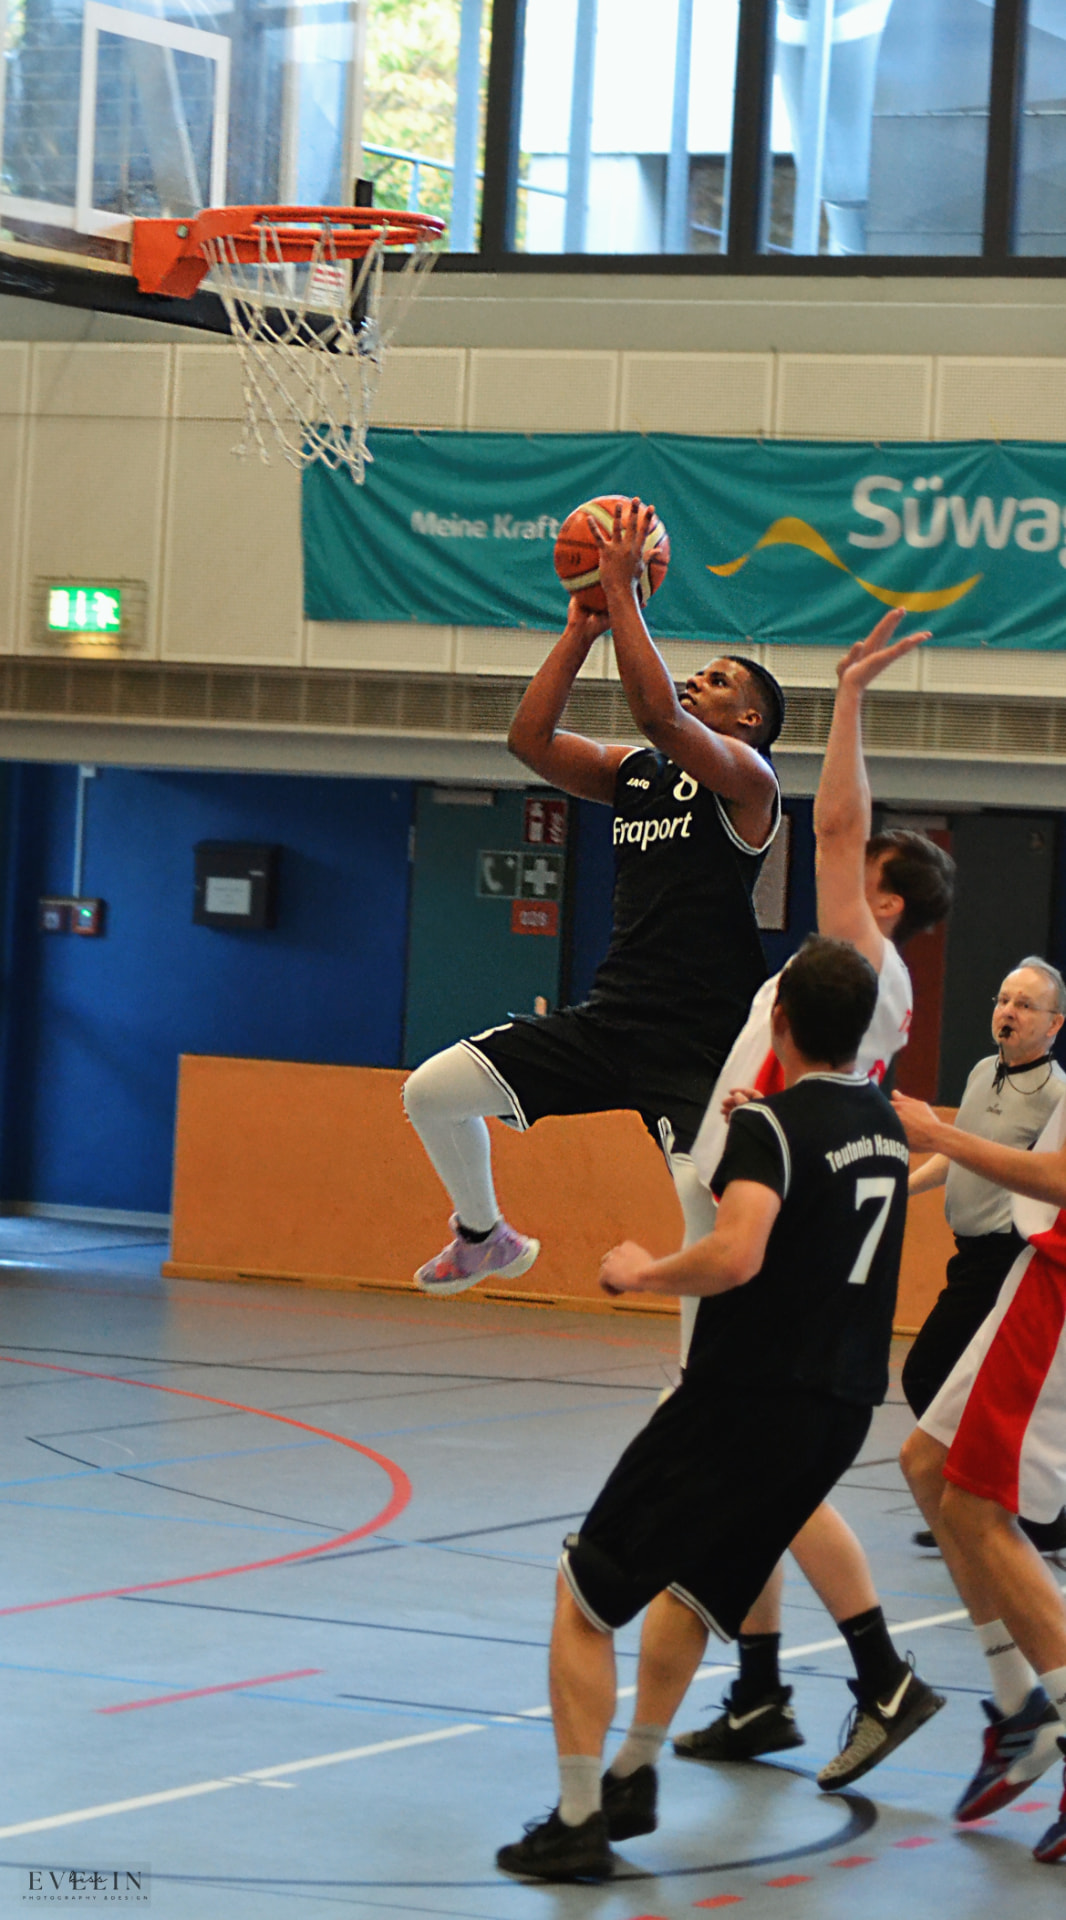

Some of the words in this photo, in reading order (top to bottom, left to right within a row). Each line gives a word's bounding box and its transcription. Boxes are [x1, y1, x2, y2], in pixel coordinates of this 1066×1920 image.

[410, 510, 488, 539] Meine
[493, 513, 558, 540] Kraft
[848, 475, 1066, 570] Süwa
[612, 811, 693, 851] Fraport
[825, 1135, 874, 1173] Teutonia
[847, 1177, 896, 1284] 7
